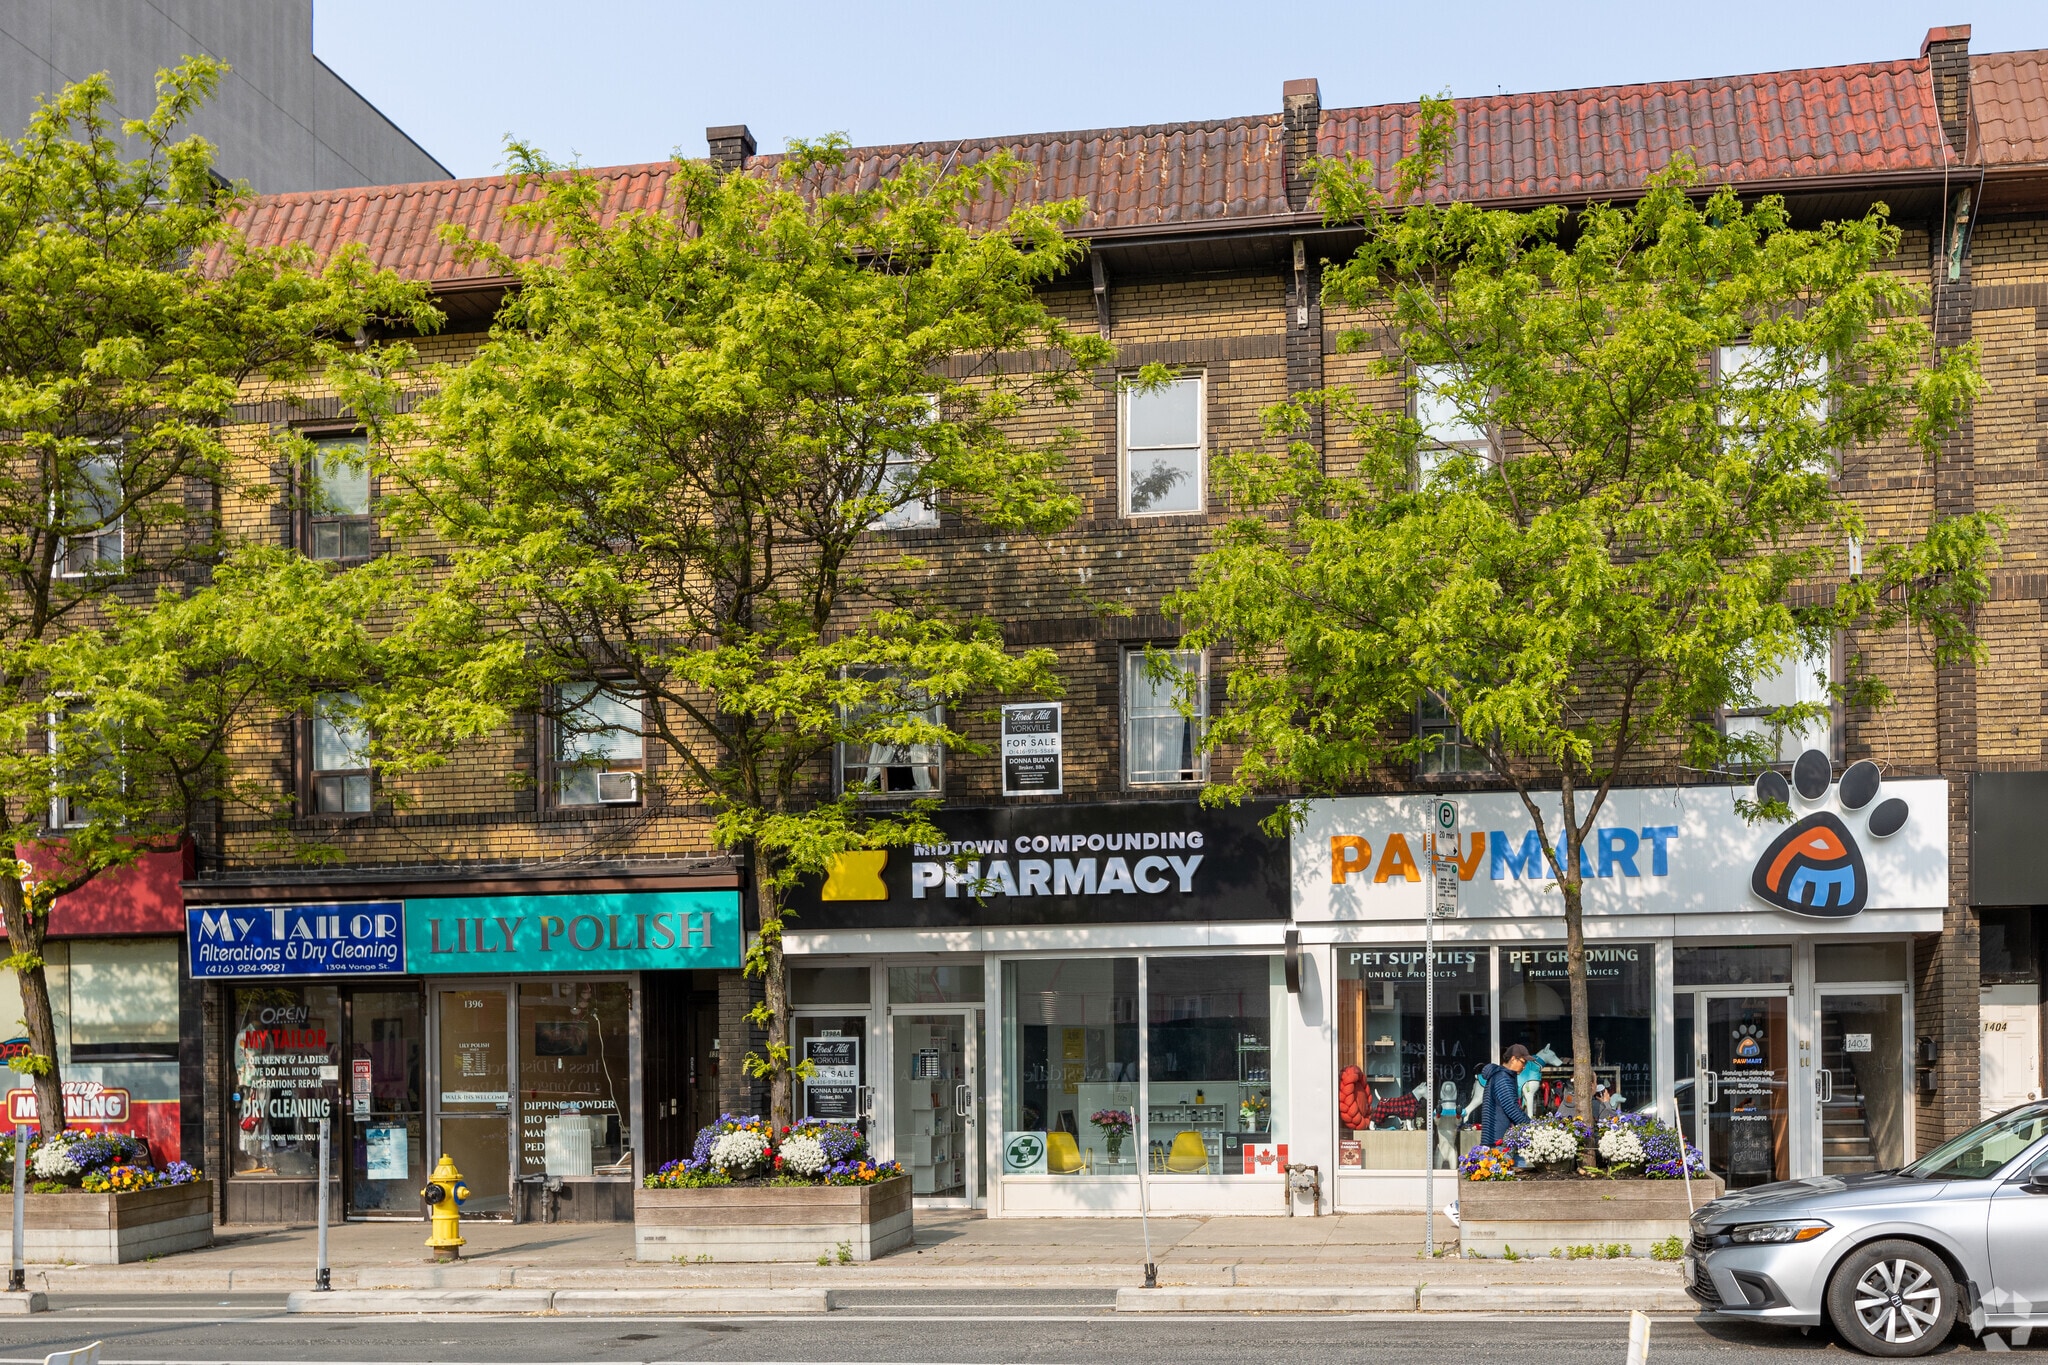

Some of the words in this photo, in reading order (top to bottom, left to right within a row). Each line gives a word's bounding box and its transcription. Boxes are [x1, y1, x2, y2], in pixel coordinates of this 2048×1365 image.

[1011, 724, 1051, 732] YORKVILLE
[1006, 739, 1027, 747] FOR
[1030, 738, 1056, 747] SALE
[1015, 831, 1204, 854] COMPOUNDING
[912, 854, 1204, 899] PHARMACY
[264, 908, 397, 940] TAILOR
[428, 916, 527, 954] LILY
[538, 912, 715, 951] POLISH
[199, 943, 281, 962] Alterations
[285, 941, 297, 960] &
[302, 942, 327, 963] Dry
[331, 940, 398, 962] Cleaning
[1509, 951, 1540, 964] PET
[1545, 949, 1639, 963] GROMING
[1350, 952, 1383, 965] PET
[205, 964, 234, 974] (416)
[237, 963, 286, 973] 924-9921
[325, 963, 347, 971] 1394
[348, 963, 376, 971] Yonge
[1586, 968, 1620, 976] RVICES
[1407, 970, 1458, 978] PROUCTS
[464, 1000, 483, 1008] 1396
[260, 1007, 308, 1024] OPEN
[1984, 1022, 2008, 1031] 1404
[244, 1030, 269, 1049] MY
[272, 1028, 327, 1049] TAILOR
[1847, 1039, 1868, 1049] 1402
[0, 1043, 30, 1059] OPE
[289, 1055, 296, 1065] &
[298, 1055, 329, 1064] LADIES
[265, 1067, 276, 1076] DO
[278, 1067, 290, 1076] ALL
[292, 1067, 310, 1076] KIND
[830, 1070, 855, 1078] SALE
[251, 1080, 297, 1089] ALTERATIONS
[298, 1079, 323, 1088] REPAIR
[16, 1096, 122, 1118] MNING
[242, 1099, 267, 1118] DRY
[269, 1098, 331, 1118] CLEANING
[524, 1101, 568, 1110] DIPPING
[569, 1100, 616, 1109] POWDER
[524, 1115, 543, 1124] BIO
